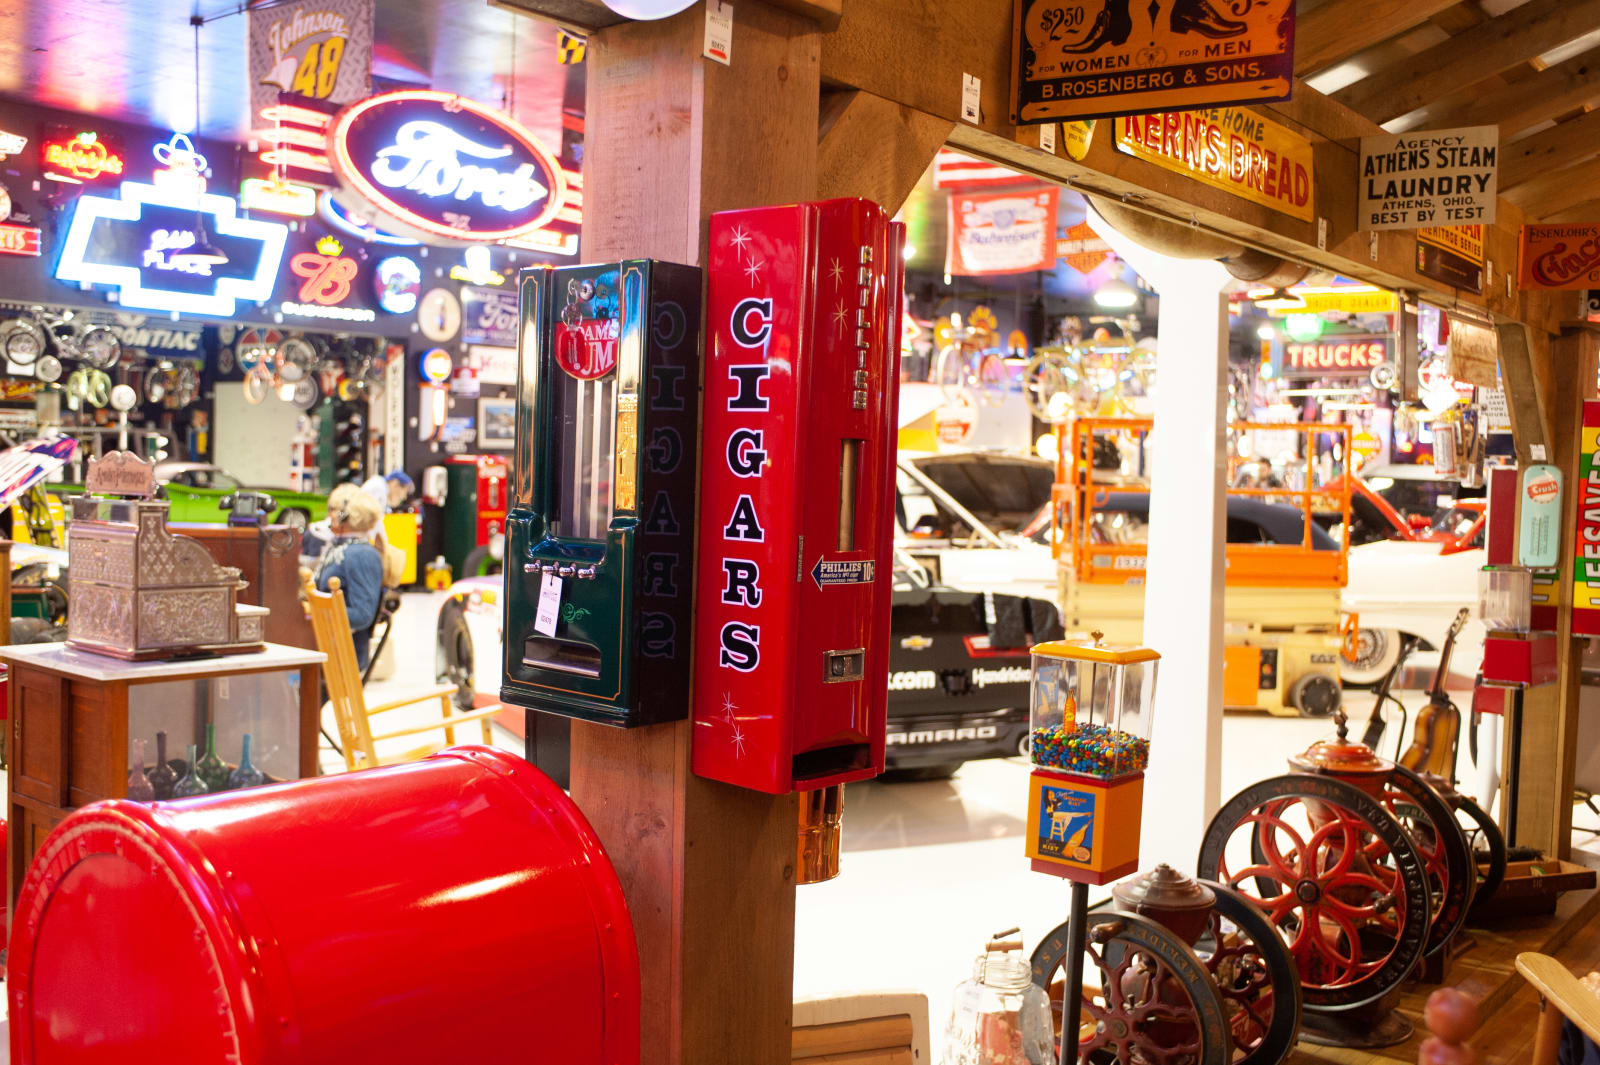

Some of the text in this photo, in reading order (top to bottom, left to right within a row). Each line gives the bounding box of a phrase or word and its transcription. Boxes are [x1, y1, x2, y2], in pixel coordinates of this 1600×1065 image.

[267, 7, 350, 58] Johnson
[1178, 39, 1253, 58] FOR MEN
[292, 36, 347, 99] 48
[1039, 53, 1131, 74] FOR WOMEN
[1182, 68, 1198, 85] &
[1204, 61, 1267, 83] SONS.
[1221, 107, 1265, 142] HOME
[1394, 135, 1466, 150] AGENCY
[370, 120, 549, 212] Ford
[1124, 111, 1310, 208] KERN'S BREAD
[1363, 146, 1497, 178] ATHENS STEAM
[1366, 172, 1493, 201] LAUNDRY
[1441, 195, 1478, 207] OHIO.
[1370, 205, 1486, 225] BEST BY TEST
[1528, 227, 1600, 244] EISENLOHR'S
[1287, 343, 1386, 368] TRUCKS
[719, 297, 774, 673] CIGARS
[1531, 481, 1558, 494] Crush
[820, 562, 862, 573] PHILLIES
[886, 725, 997, 746] AMARO
